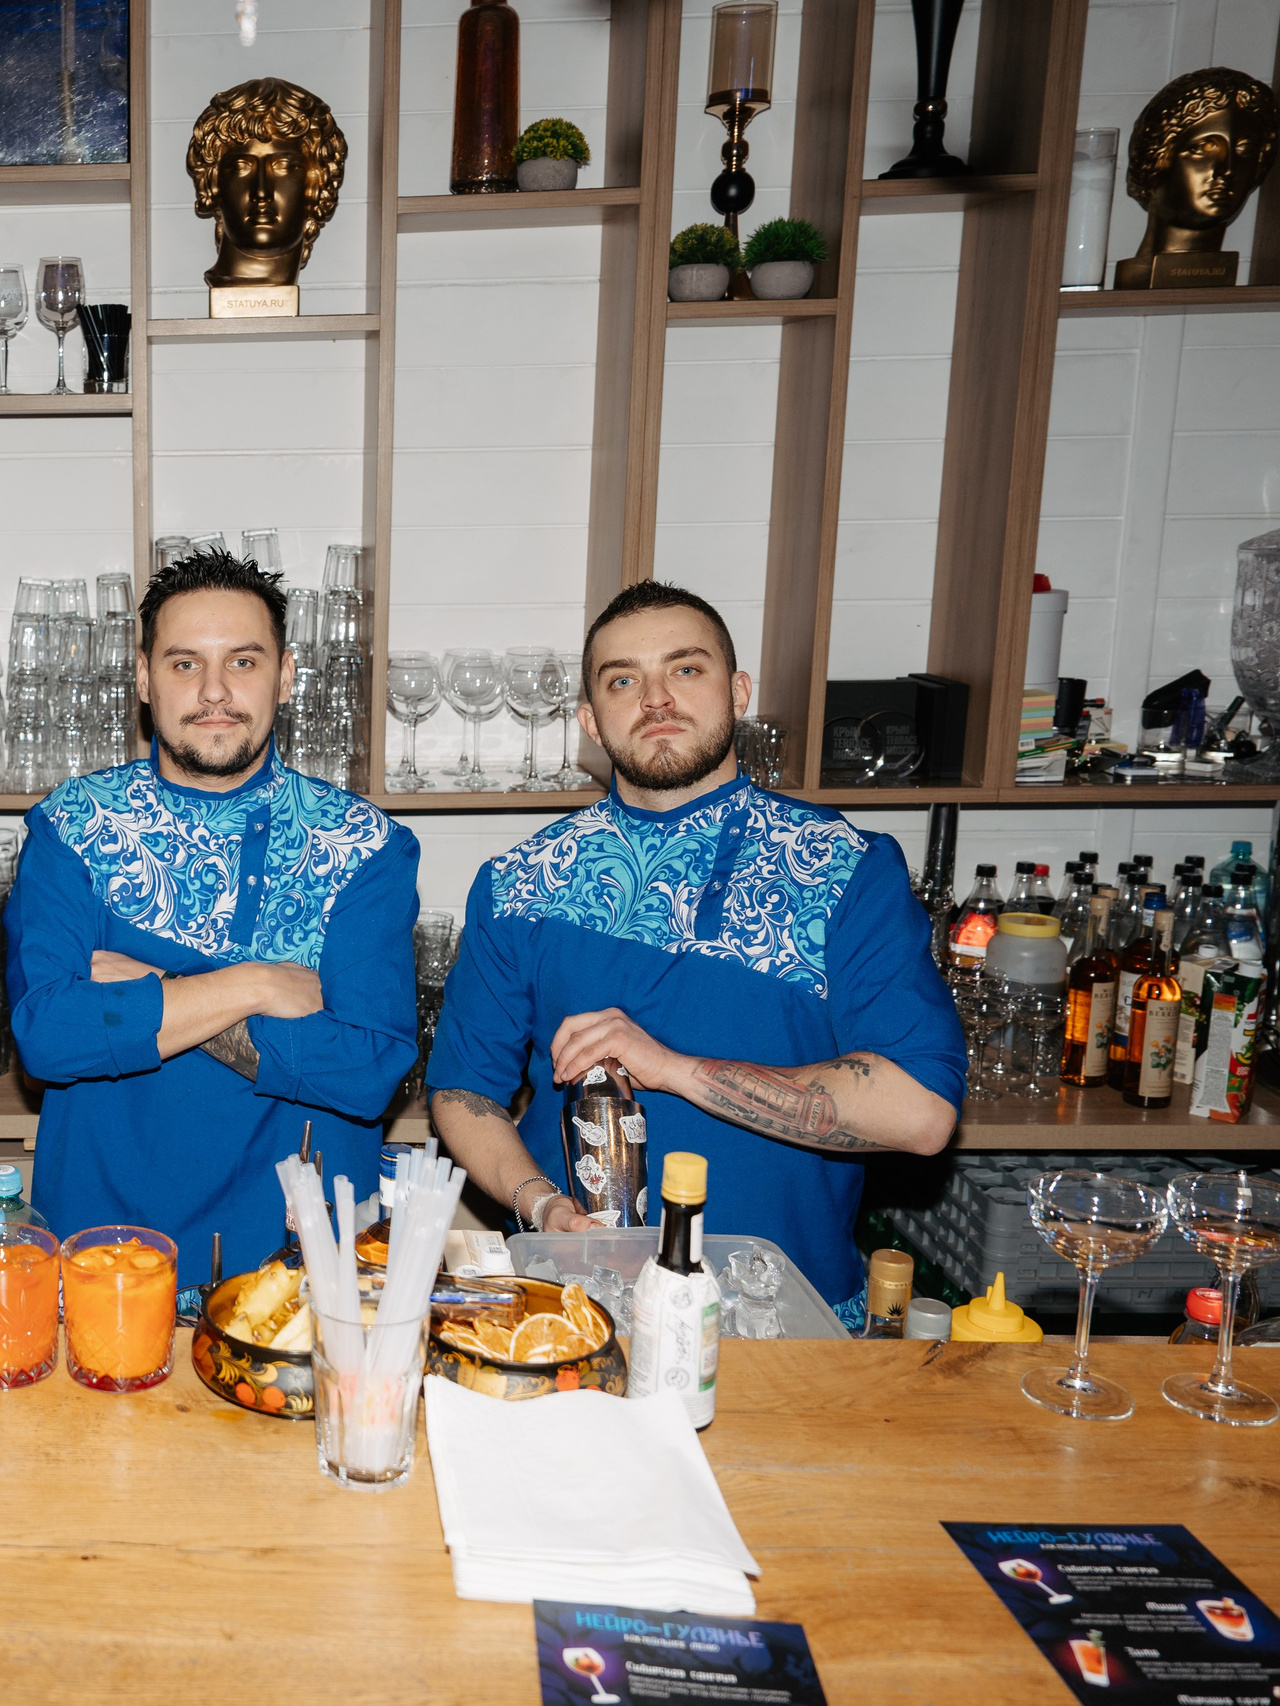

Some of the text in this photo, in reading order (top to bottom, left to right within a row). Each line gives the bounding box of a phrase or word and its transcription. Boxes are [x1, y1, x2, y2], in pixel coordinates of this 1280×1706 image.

[226, 299, 285, 309] STATUYA.RU
[833, 738, 872, 748] TERRACE
[986, 1530, 1163, 1546] НЕЙРО-ГУЛЯНЬЕ
[575, 1610, 765, 1649] НЕЙРО-ГУЛЯНЬЕ
